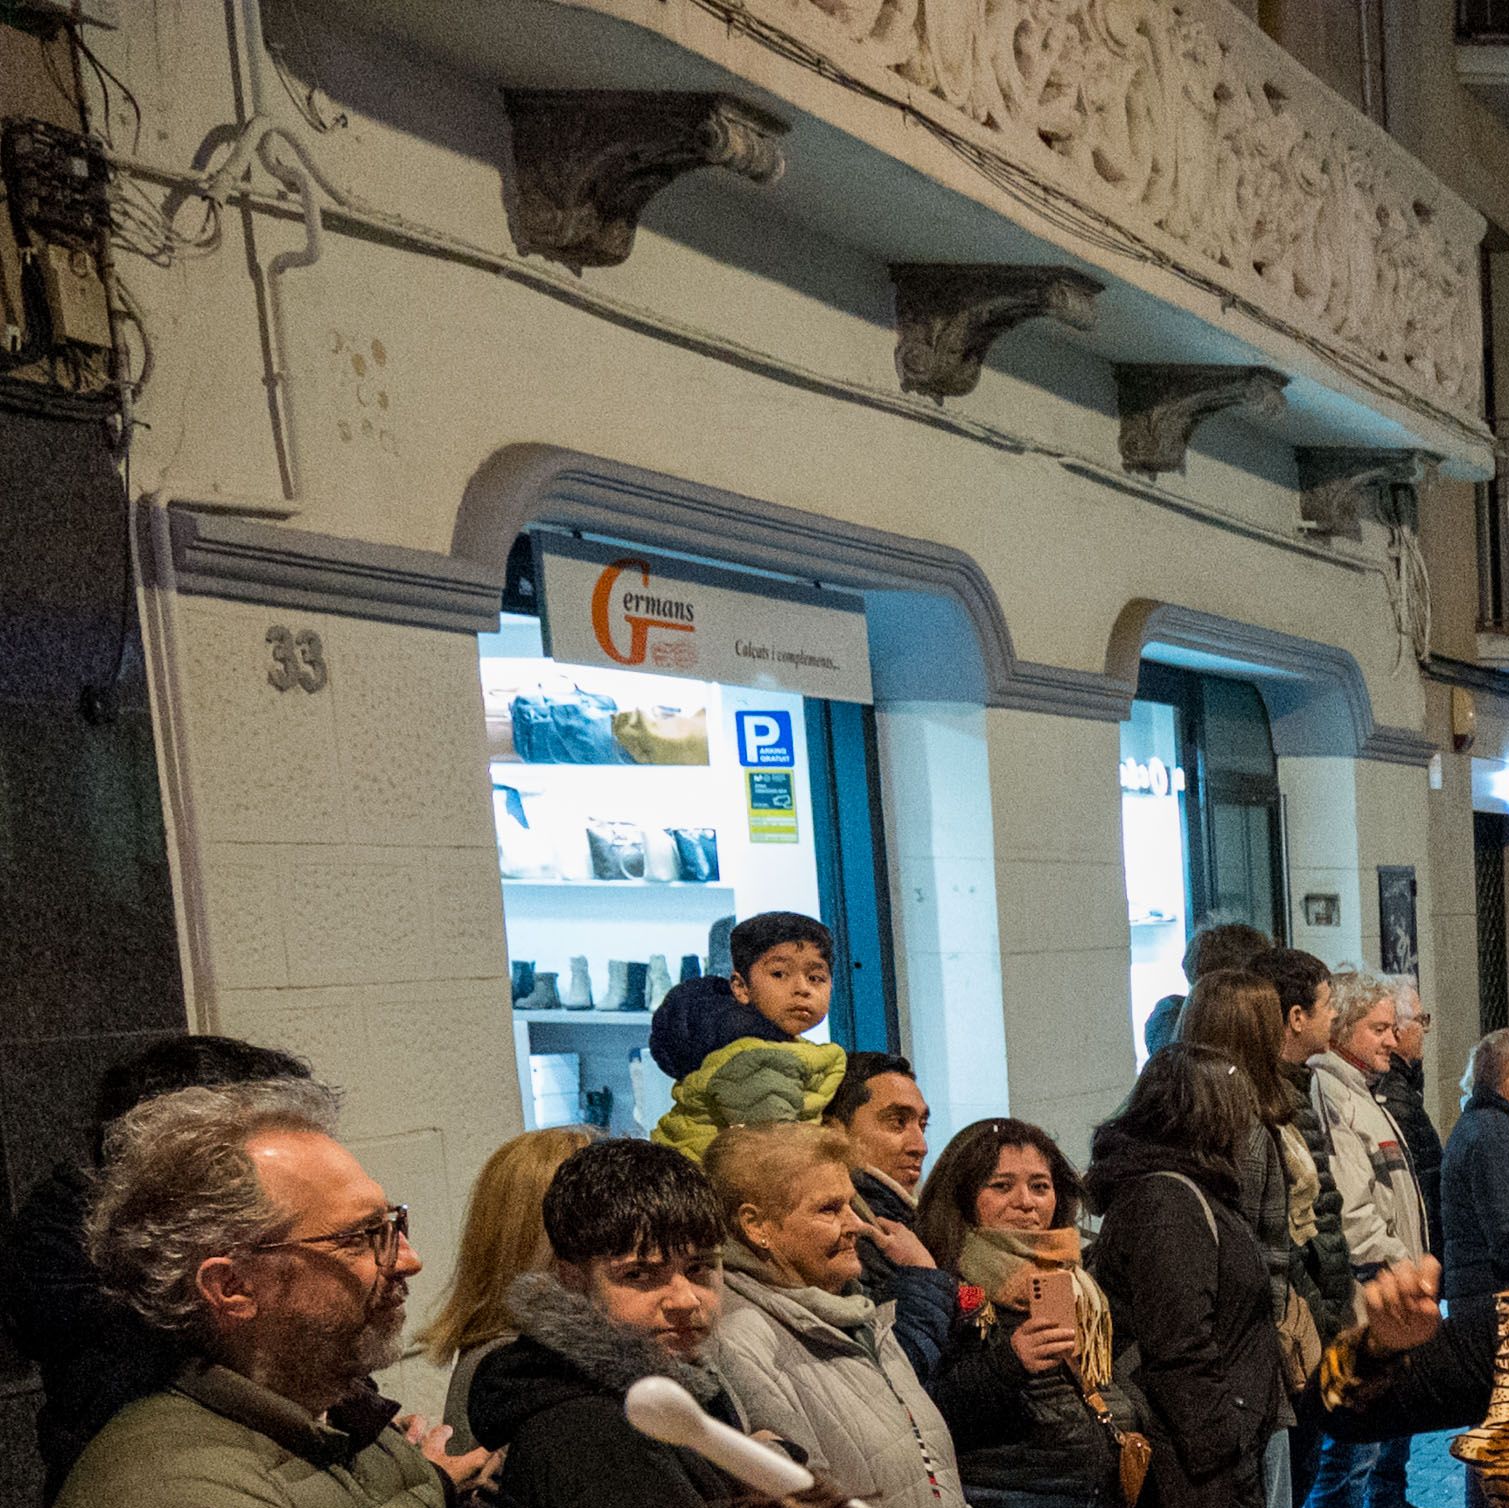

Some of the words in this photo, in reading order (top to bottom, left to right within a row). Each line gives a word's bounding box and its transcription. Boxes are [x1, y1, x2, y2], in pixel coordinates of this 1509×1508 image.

[591, 557, 695, 666] Germans
[265, 624, 328, 694] 33
[743, 715, 780, 763] P
